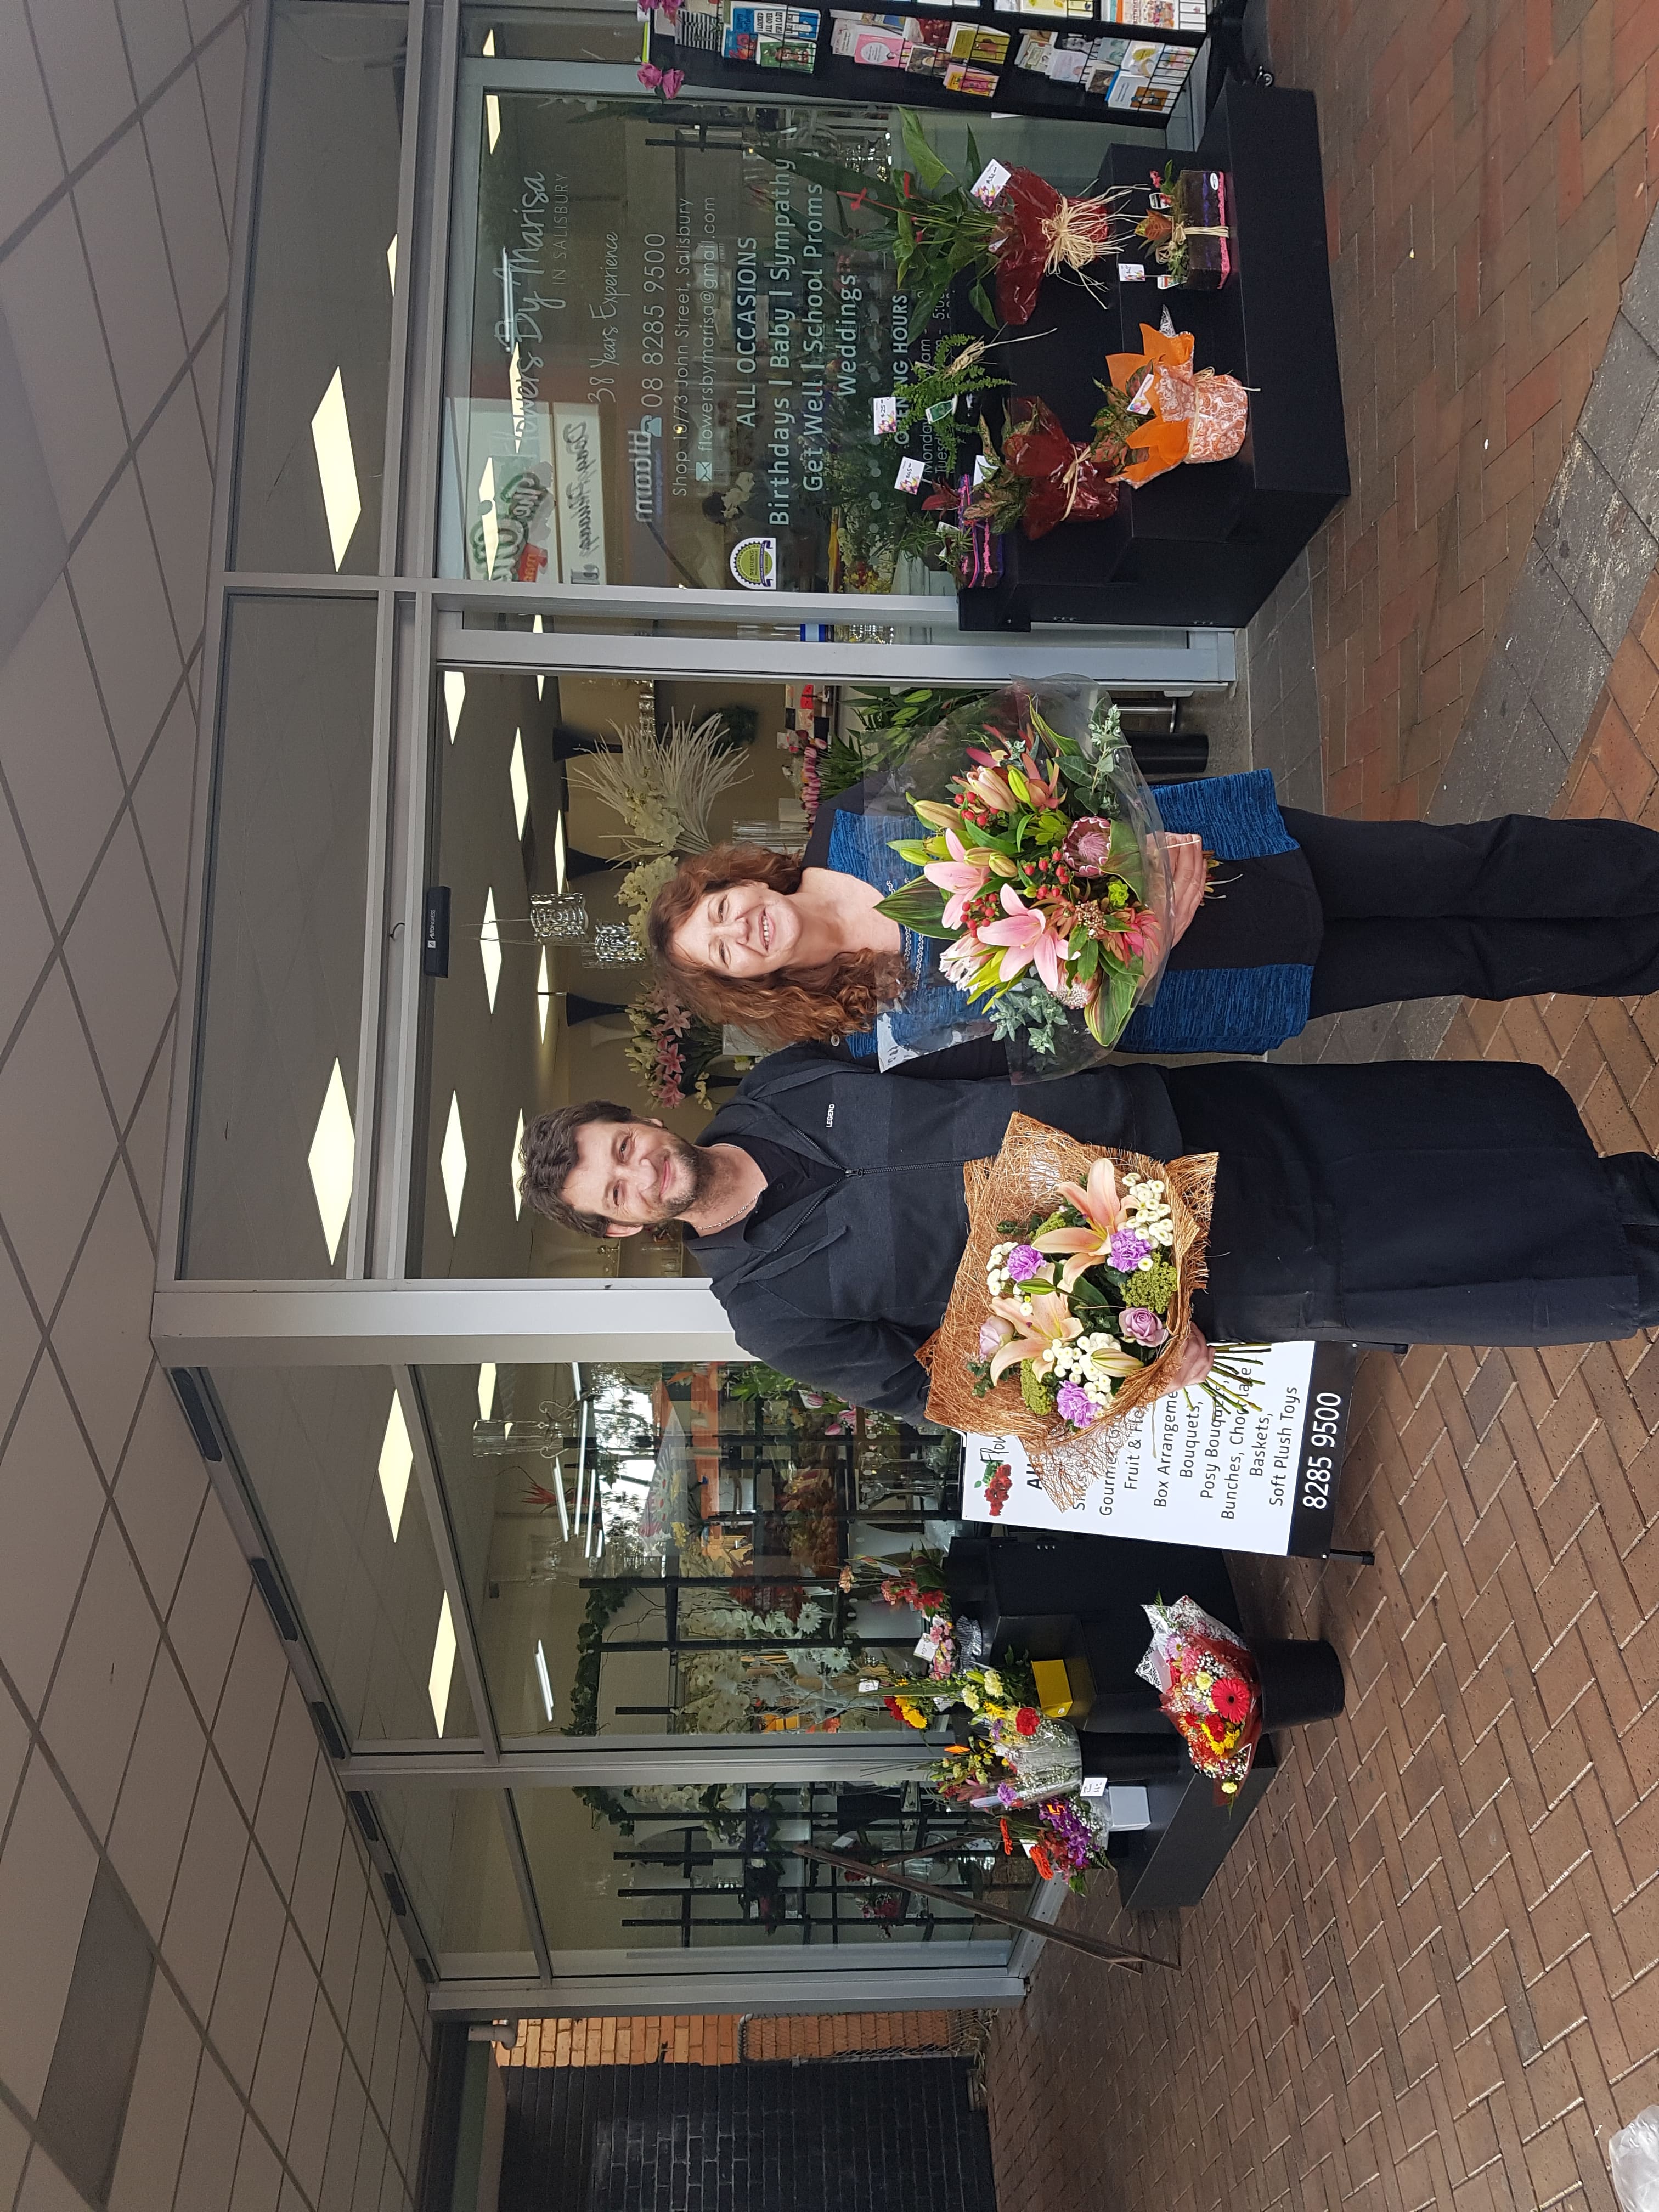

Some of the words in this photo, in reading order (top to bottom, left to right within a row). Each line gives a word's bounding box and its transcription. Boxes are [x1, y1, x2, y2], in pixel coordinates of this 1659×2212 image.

[492, 172, 549, 286] Marisa
[552, 172, 569, 259] SALISBURY
[676, 198, 693, 275] Salisbury
[770, 157, 796, 281] Sympathy
[803, 184, 823, 258] Proms
[552, 268, 567, 285] IN
[589, 231, 631, 319] Experience
[643, 234, 666, 292] 9500
[494, 290, 566, 346] By
[675, 283, 691, 338] Street,
[697, 197, 716, 452] flowersbymarisa@gmail.com
[737, 236, 757, 374] OCCASIONS
[803, 269, 823, 353] School
[892, 295, 909, 353] HOURS
[589, 325, 620, 368] Years
[642, 304, 665, 365] 8285
[769, 308, 795, 368] Baby
[836, 275, 862, 397] Weddings
[588, 376, 616, 402] 38
[641, 377, 663, 407] 08
[674, 345, 689, 387] John
[490, 351, 550, 458] Flowers
[673, 395, 689, 440] 10/73
[737, 384, 756, 427] ALL
[803, 380, 823, 436] Well
[893, 360, 910, 445] OENNG
[673, 451, 690, 496] Shop
[769, 397, 795, 526] Birthdays
[803, 447, 823, 492] Get
[825, 1104, 834, 1127] LEGEND
[1279, 1387, 1300, 1421] Toys
[1311, 1392, 1342, 1448] 9500
[1127, 1439, 1141, 1449] &
[1157, 1391, 1178, 1475] Arrangeme
[1180, 1401, 1203, 1478] Bouquets,
[1249, 1413, 1273, 1476] Baskets,
[1273, 1427, 1292, 1469] Plush
[1099, 1458, 1117, 1516] Gourme
[1124, 1455, 1141, 1489] Fruit
[1153, 1481, 1169, 1507] Box
[1200, 1463, 1221, 1499] Posy
[1221, 1452, 1245, 1519] Bunches,
[1269, 1474, 1286, 1506] Soft
[1302, 1455, 1332, 1509] 8285
